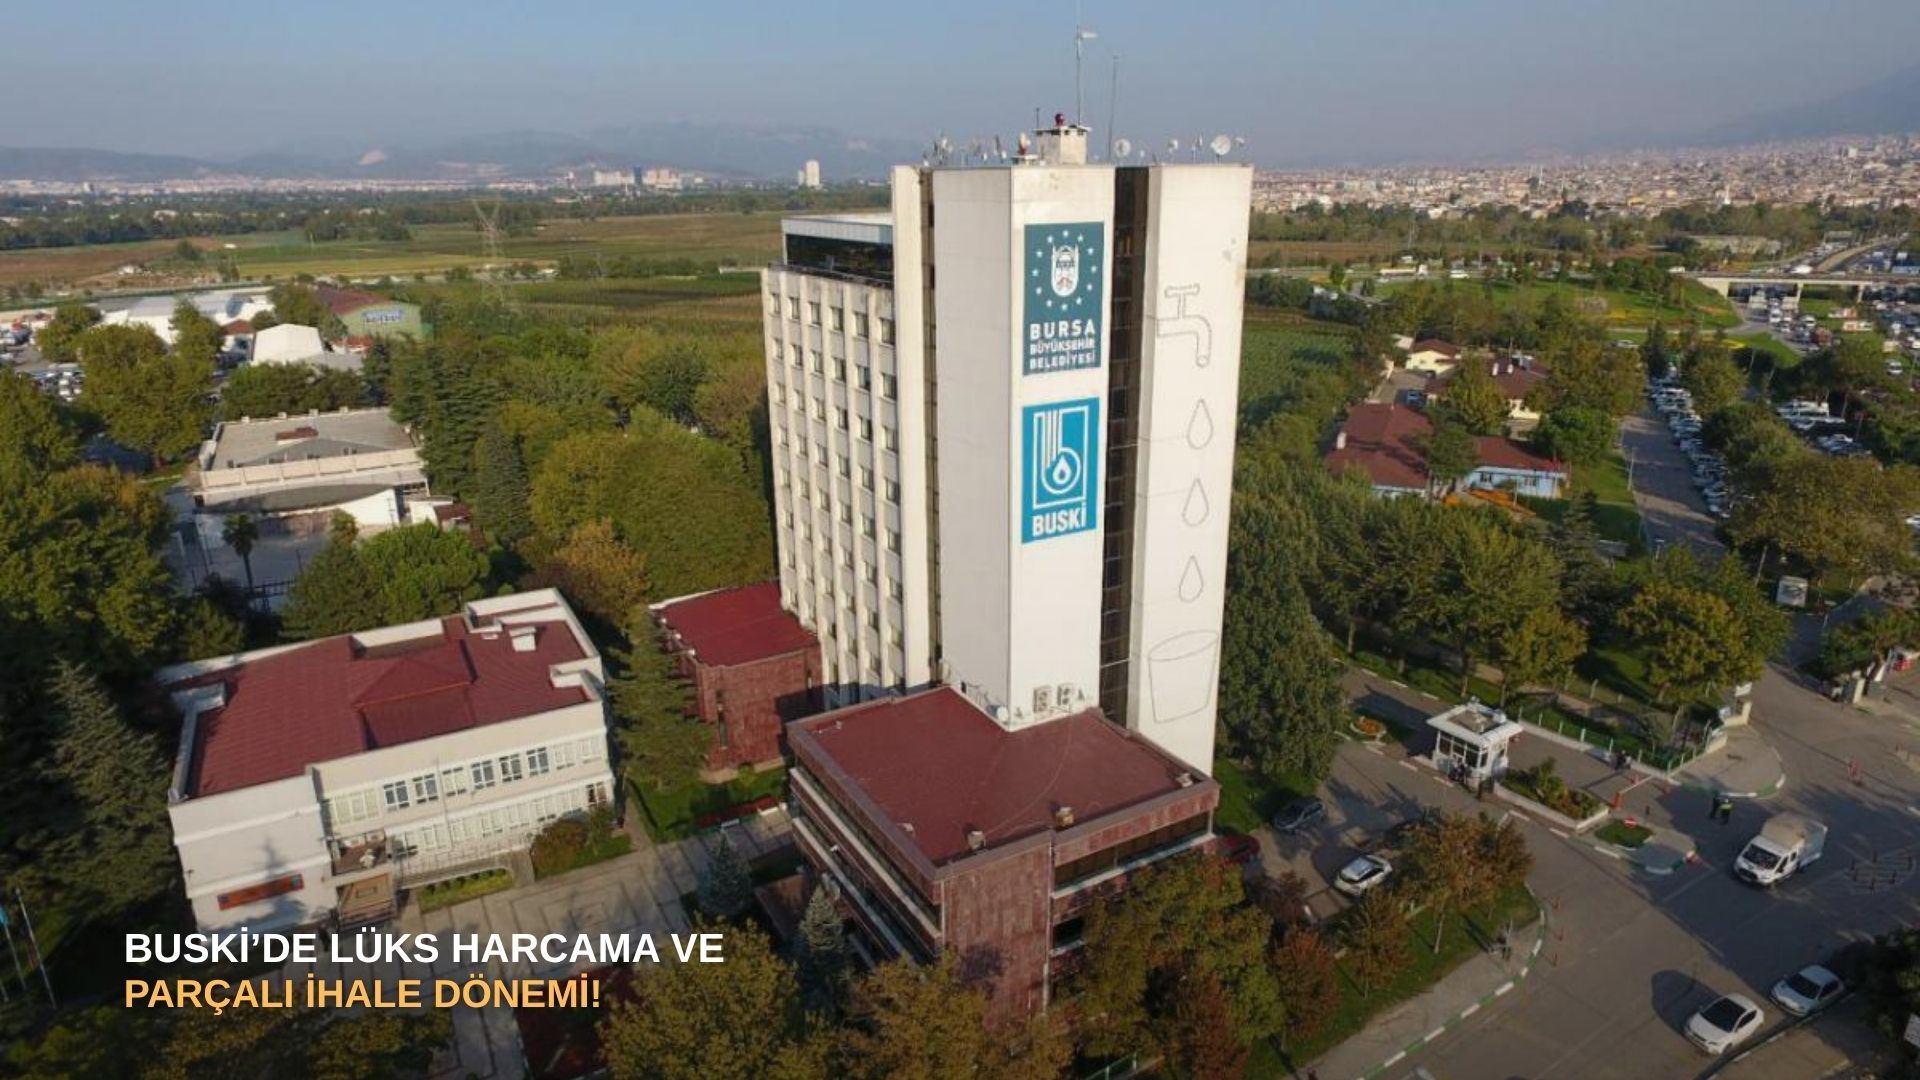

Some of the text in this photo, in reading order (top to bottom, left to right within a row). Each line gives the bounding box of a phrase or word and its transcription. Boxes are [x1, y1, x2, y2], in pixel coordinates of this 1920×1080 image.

[1029, 318, 1096, 341] BURSA
[1029, 350, 1096, 370] BELEDİYESİ
[1032, 501, 1087, 537] BUSKİ
